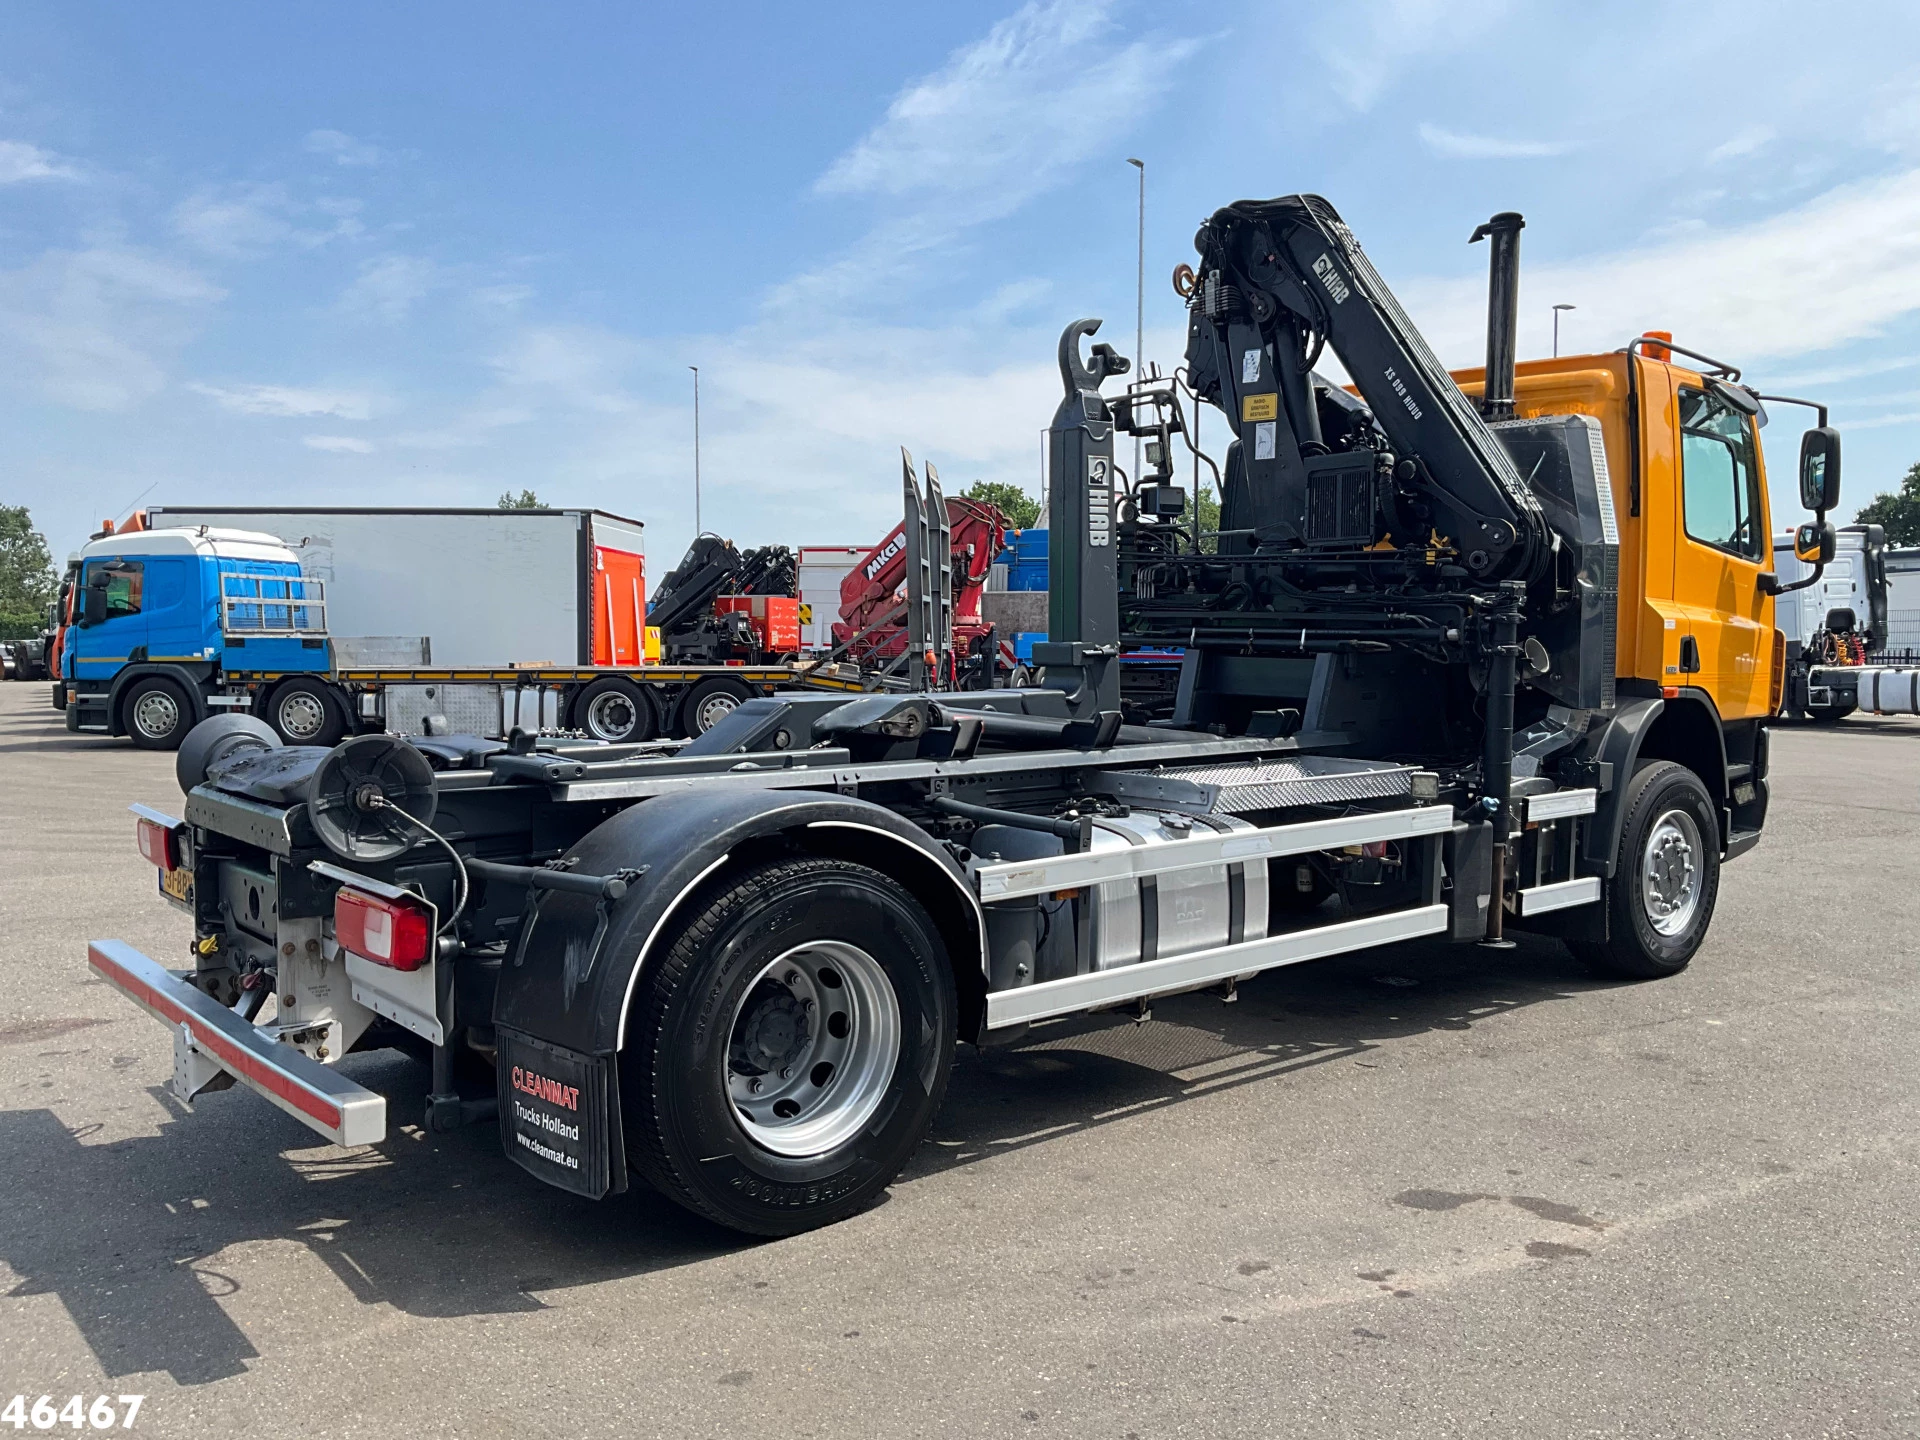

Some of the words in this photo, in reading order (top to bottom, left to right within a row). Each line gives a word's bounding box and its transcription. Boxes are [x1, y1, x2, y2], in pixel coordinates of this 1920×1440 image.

[1322, 268, 1350, 305] HIAB
[1384, 366, 1396, 381] XS
[1392, 379, 1405, 397] 099
[1402, 395, 1423, 420] HIDUO
[1089, 489, 1109, 547] HIAB
[866, 542, 899, 581] MKG
[511, 1065, 580, 1112] CLEANMAT
[515, 1100, 541, 1126] Trucks
[541, 1112, 579, 1141] Holland
[516, 1131, 578, 1169] www.cleanmat.eu
